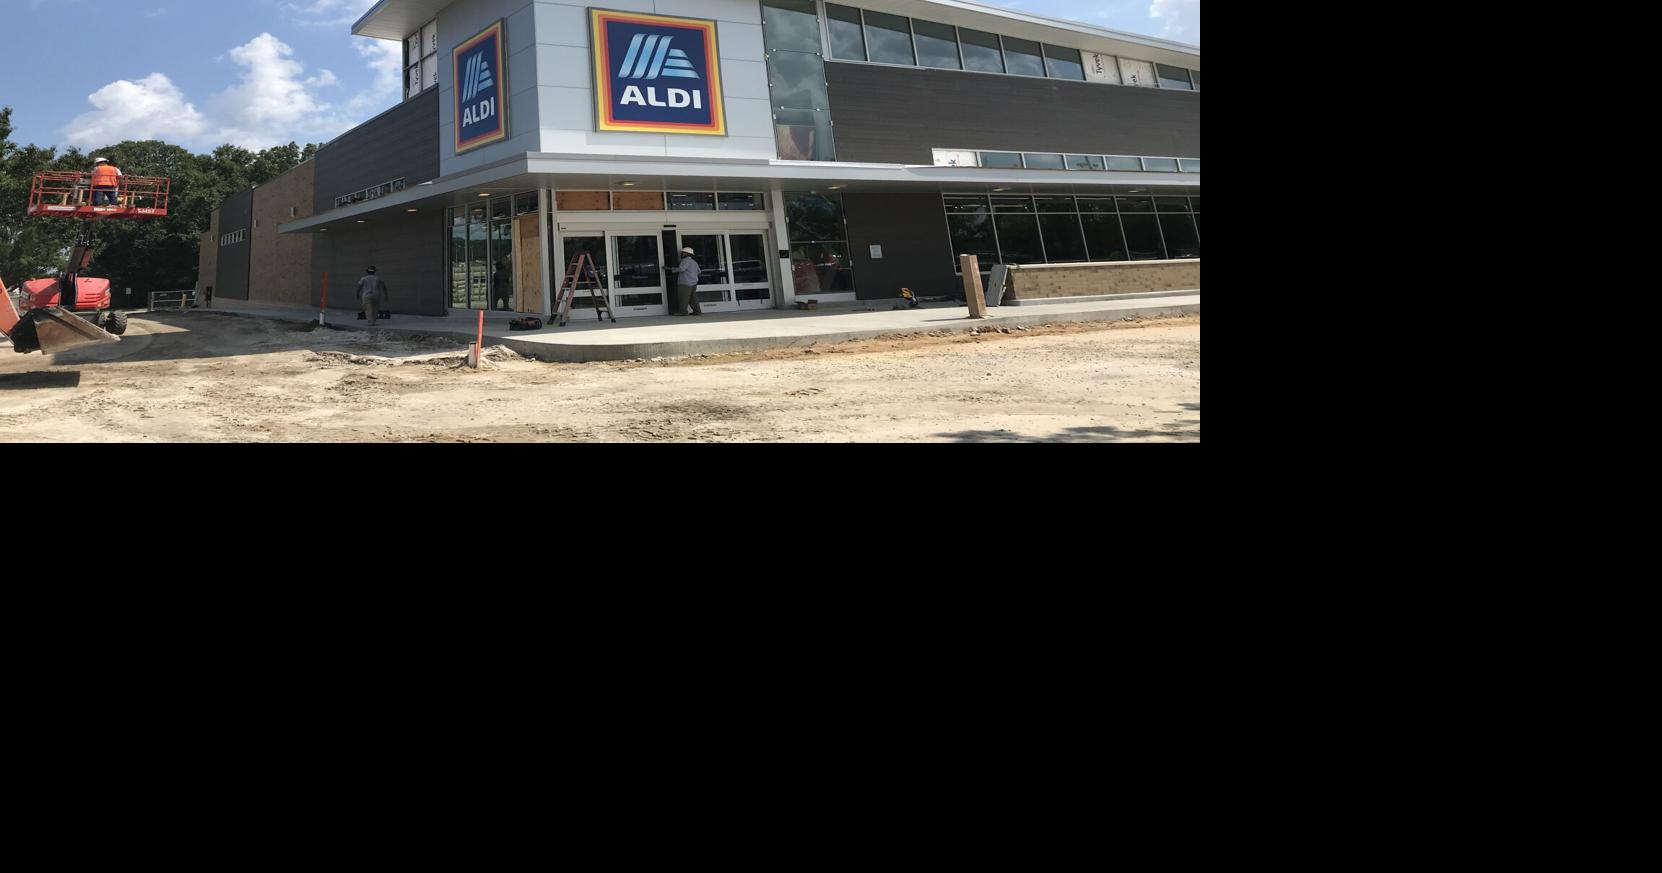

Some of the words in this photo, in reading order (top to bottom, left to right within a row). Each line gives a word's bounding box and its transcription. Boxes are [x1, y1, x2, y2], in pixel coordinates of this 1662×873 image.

[1093, 53, 1104, 75] Tyvek
[620, 85, 702, 110] ALDI
[462, 96, 495, 128] ALDI
